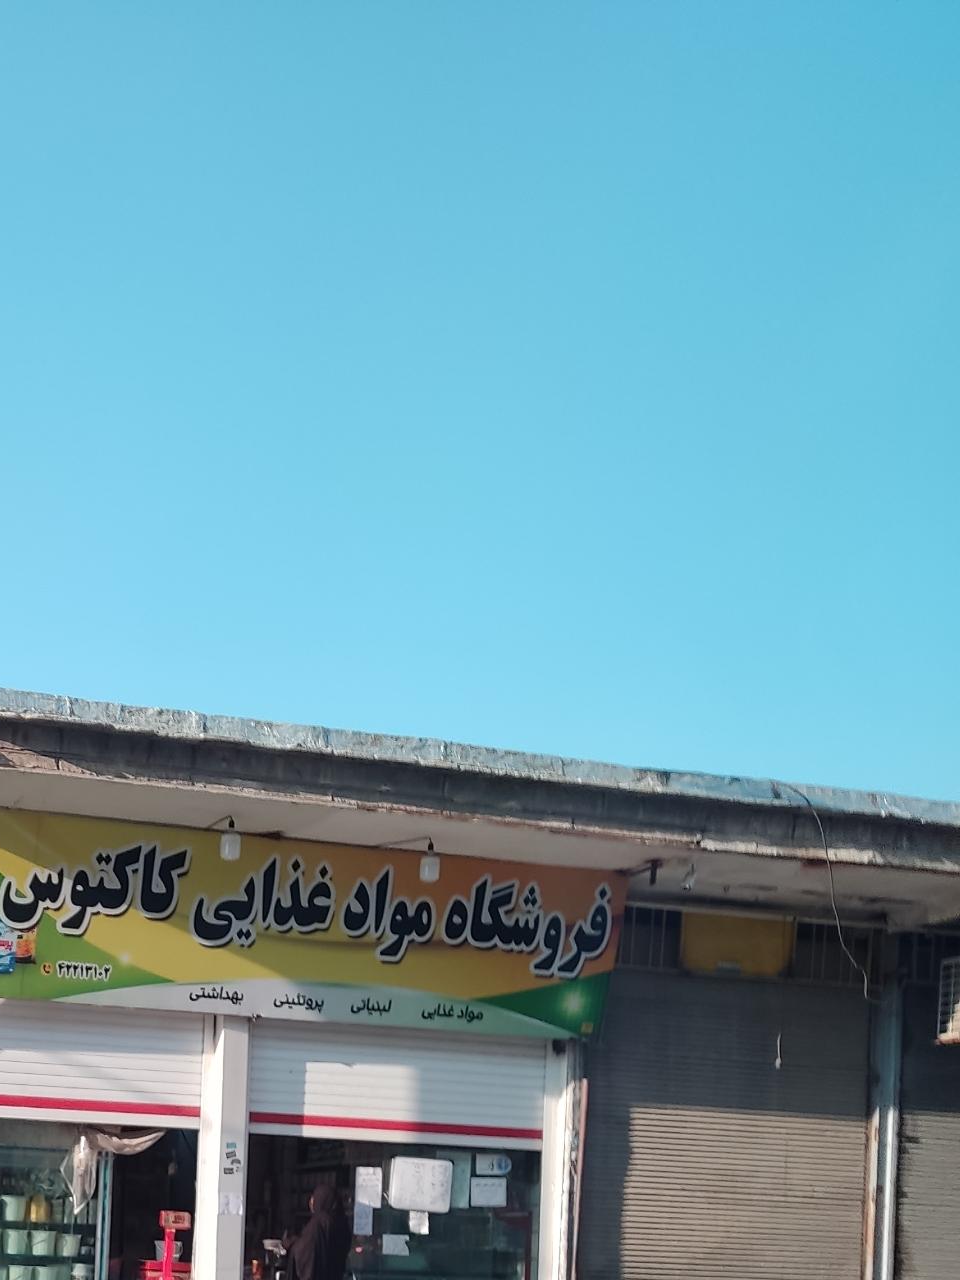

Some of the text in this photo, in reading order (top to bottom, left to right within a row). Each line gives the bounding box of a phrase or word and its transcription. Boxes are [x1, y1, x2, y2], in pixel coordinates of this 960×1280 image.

[1, 843, 611, 975] فروشگاه مواد غذایی کاکتوس
[189, 986, 244, 1005] بهداشتی
[421, 1003, 455, 1020] غذایی
[457, 1005, 484, 1022] مواد
